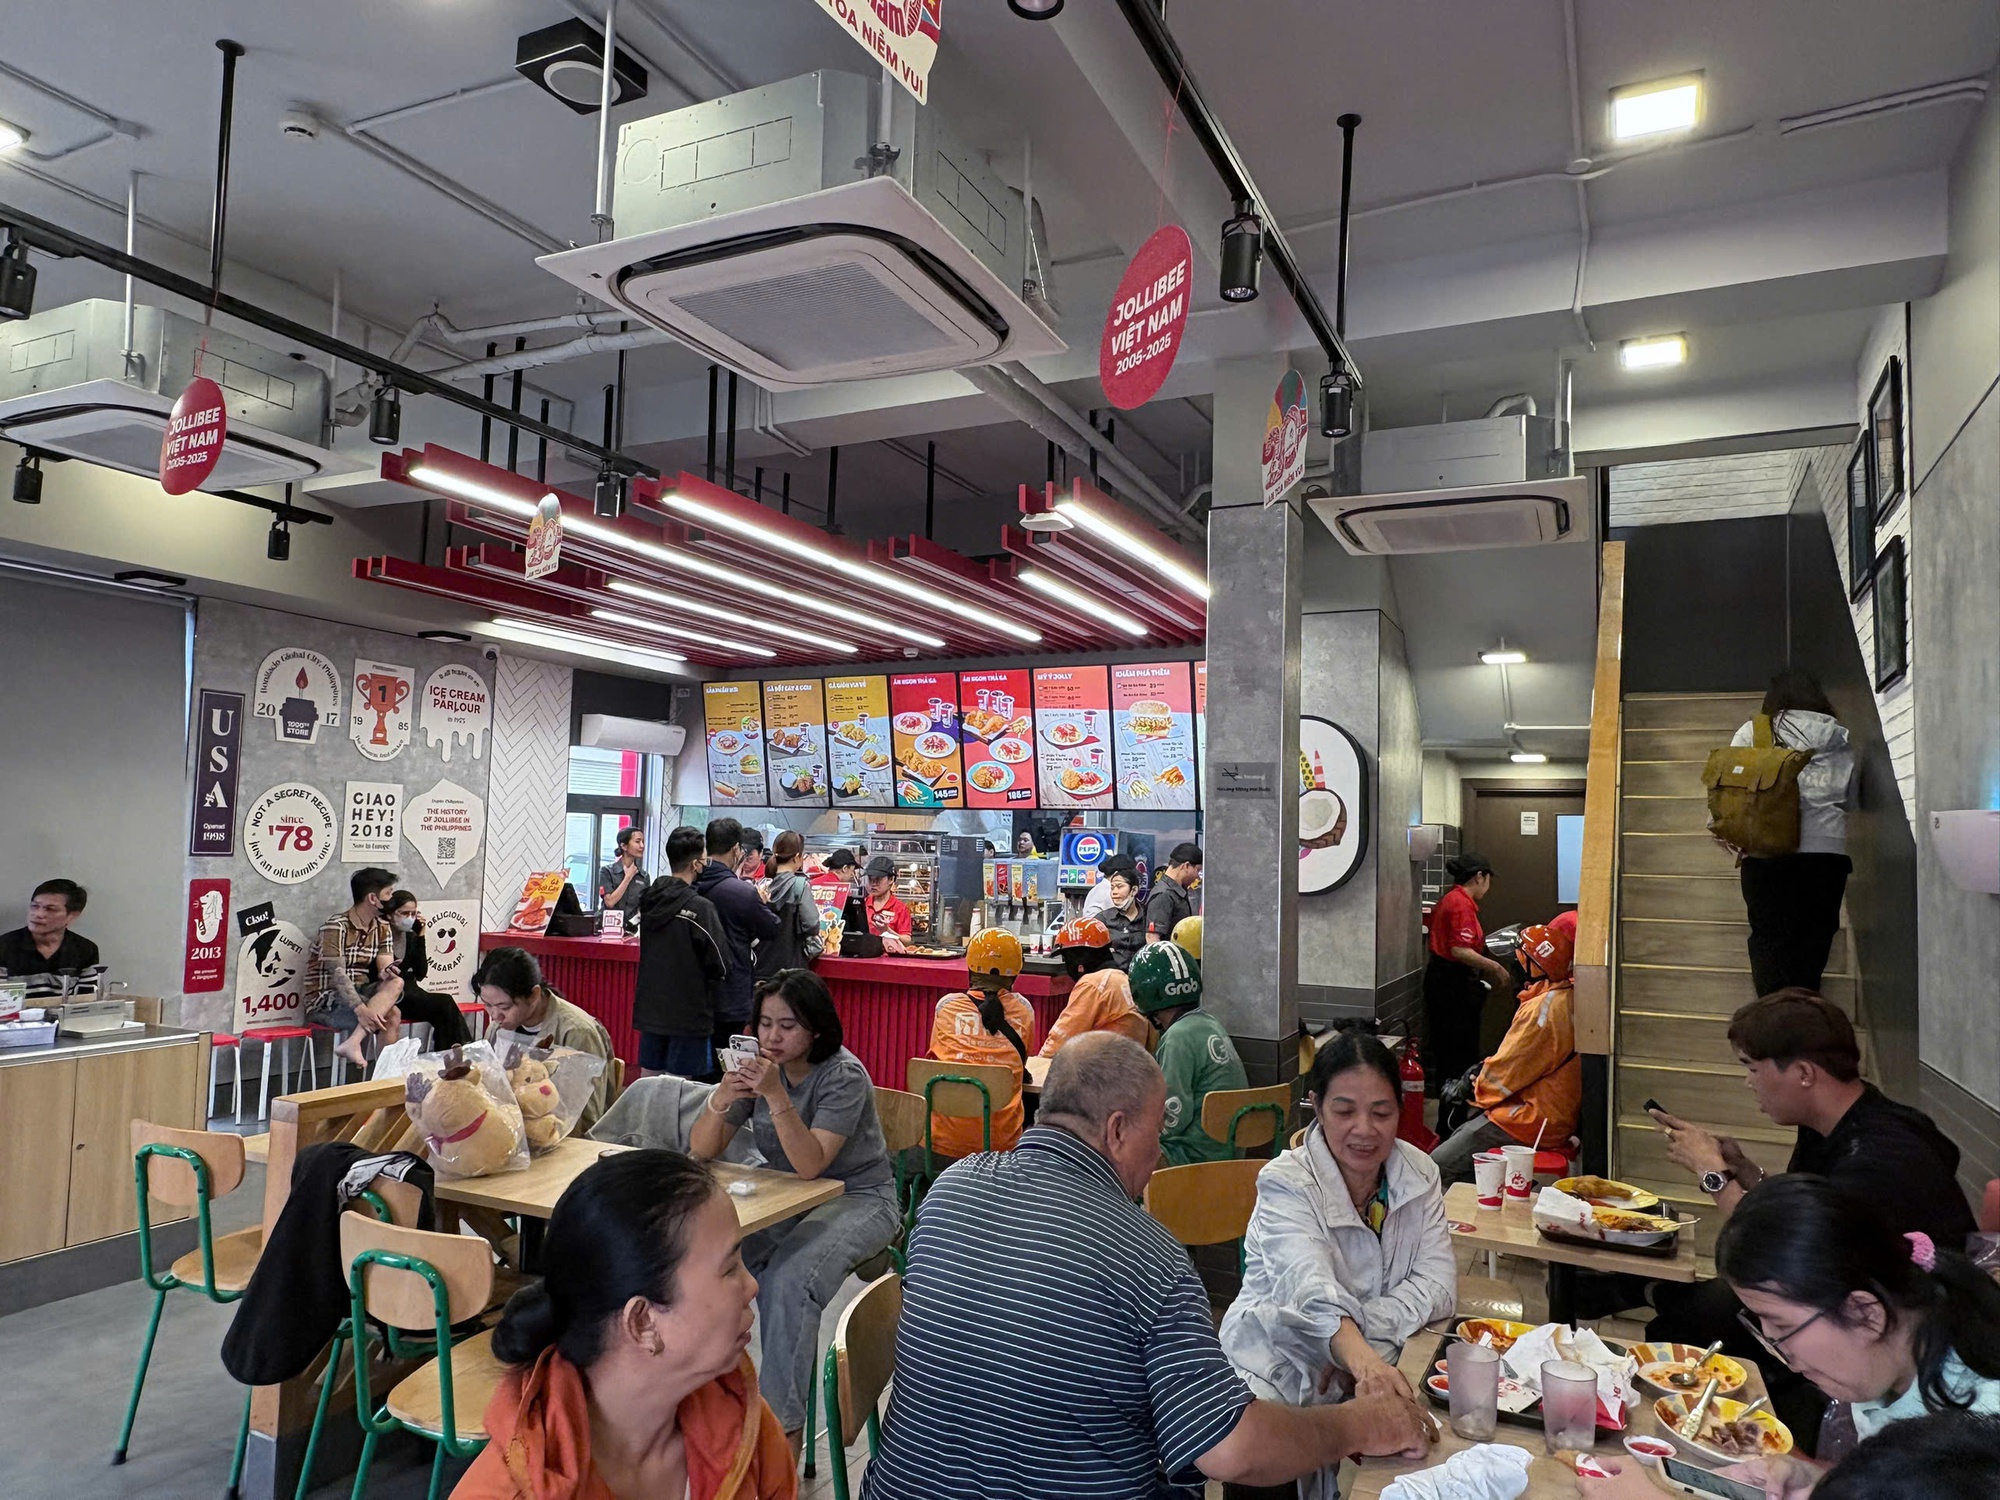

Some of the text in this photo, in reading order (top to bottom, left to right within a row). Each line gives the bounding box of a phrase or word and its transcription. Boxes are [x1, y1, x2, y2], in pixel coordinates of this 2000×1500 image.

[862, 20, 898, 72] NIỀM
[901, 60, 923, 98] VUI
[1113, 259, 1187, 327] JOLLIBEE
[1111, 292, 1184, 358] VIỆT NAM
[1114, 332, 1172, 376] 2005-2025
[168, 406, 222, 436] JOLLIBEE
[166, 428, 219, 461] VIỆT NAM
[166, 451, 208, 471] 2005-2025
[280, 651, 306, 662] Global
[378, 685, 386, 702] 1
[429, 685, 485, 703] ICE CREAM
[257, 702, 338, 725] 20 17
[433, 698, 480, 714] PARLOUR
[286, 728, 309, 736] STORE
[353, 716, 409, 731] 19 85
[203, 708, 235, 808] USA
[353, 792, 396, 806] CIAO
[251, 789, 332, 829] NOT A SECRET RECIPE
[352, 808, 394, 822] HEY!
[440, 808, 468, 816] HISTORY
[280, 815, 304, 824] since
[203, 832, 225, 841] 1998
[268, 825, 313, 852] '78
[350, 824, 393, 838] 2018
[249, 841, 331, 878] just an old family one
[245, 911, 269, 927] Ciao!
[426, 910, 468, 929] DELICIOUS!
[190, 946, 222, 960] 2013
[278, 935, 303, 954] LUPET!
[426, 953, 465, 972] MASARAP!
[1164, 979, 1199, 996] Grab
[242, 992, 300, 1017] 1,400
